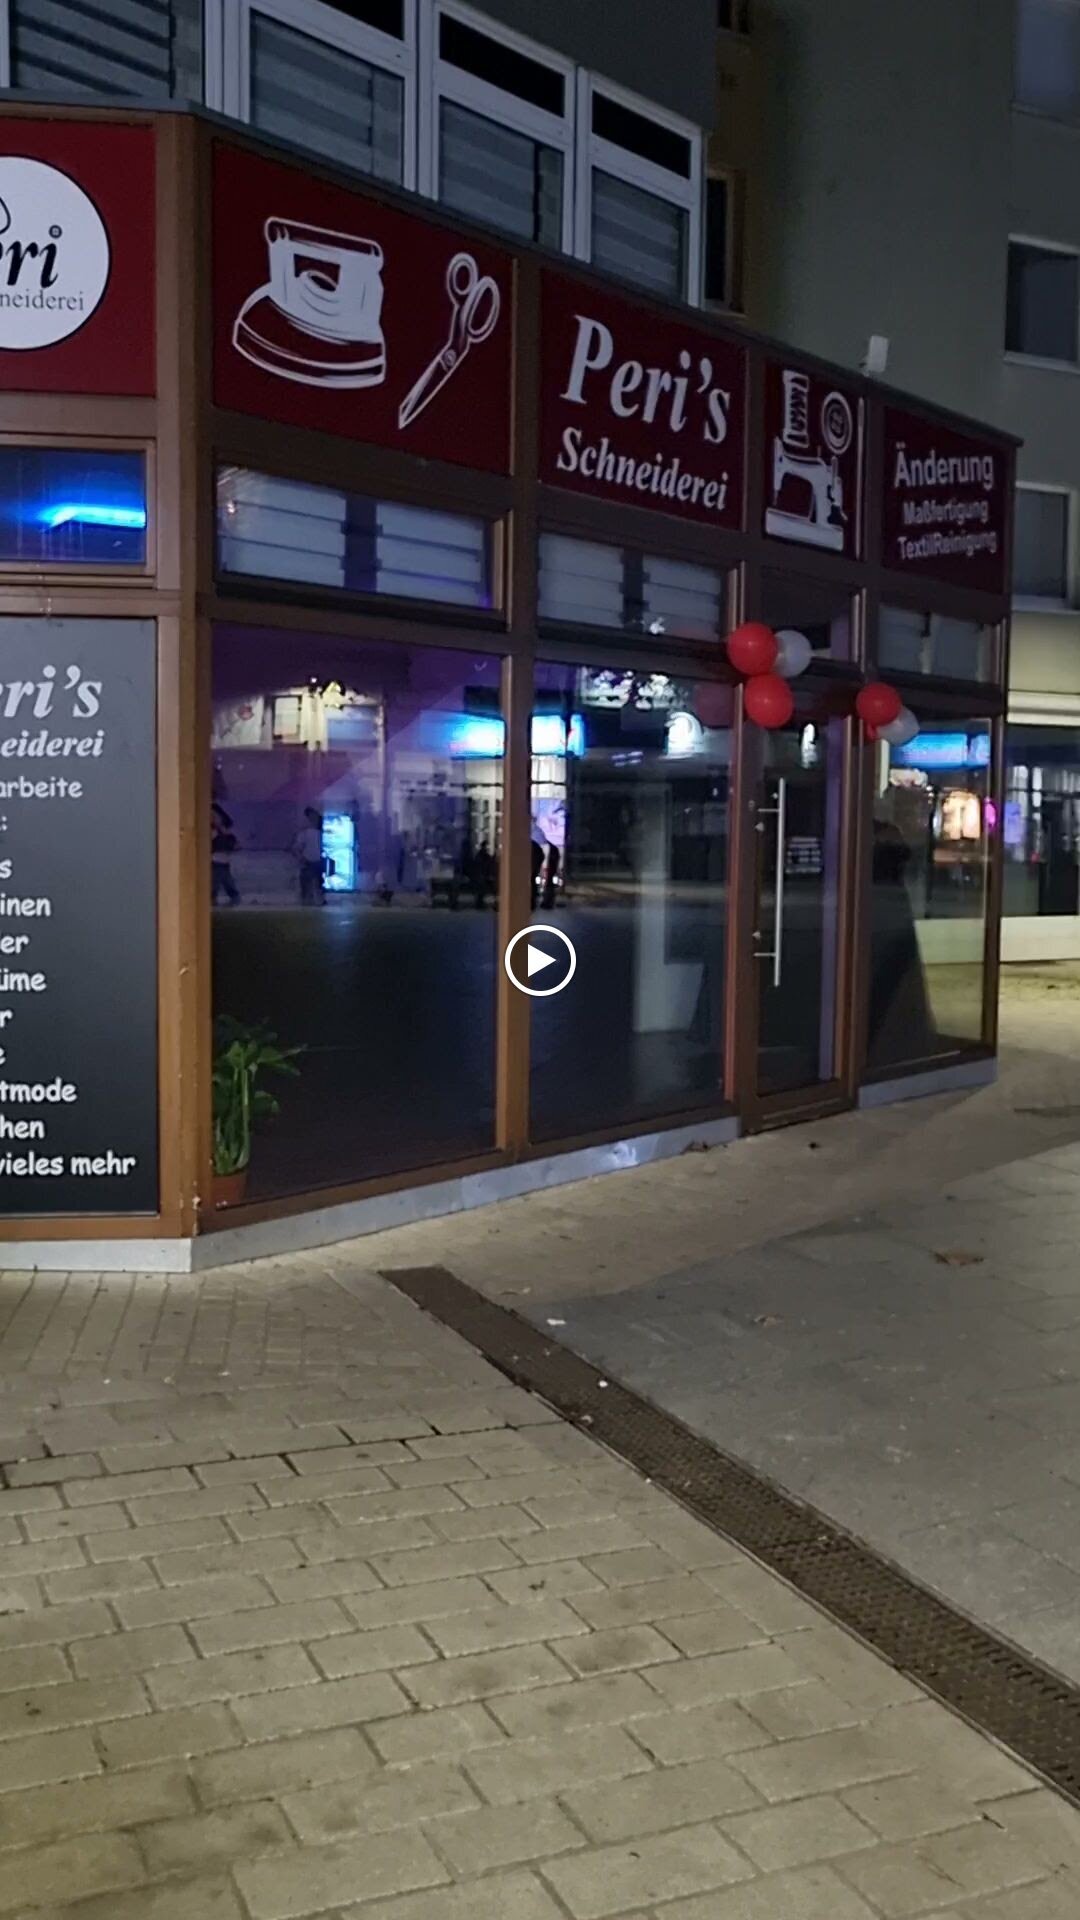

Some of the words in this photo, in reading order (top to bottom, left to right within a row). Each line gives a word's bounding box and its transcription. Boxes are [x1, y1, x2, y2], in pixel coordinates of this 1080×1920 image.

[0, 225, 62, 289] ri
[560, 315, 730, 443] Peri's
[557, 427, 728, 510] Schneiderei
[895, 442, 993, 491] Änderung
[0, 665, 103, 718] ri's
[70, 1150, 136, 1176] mehr
